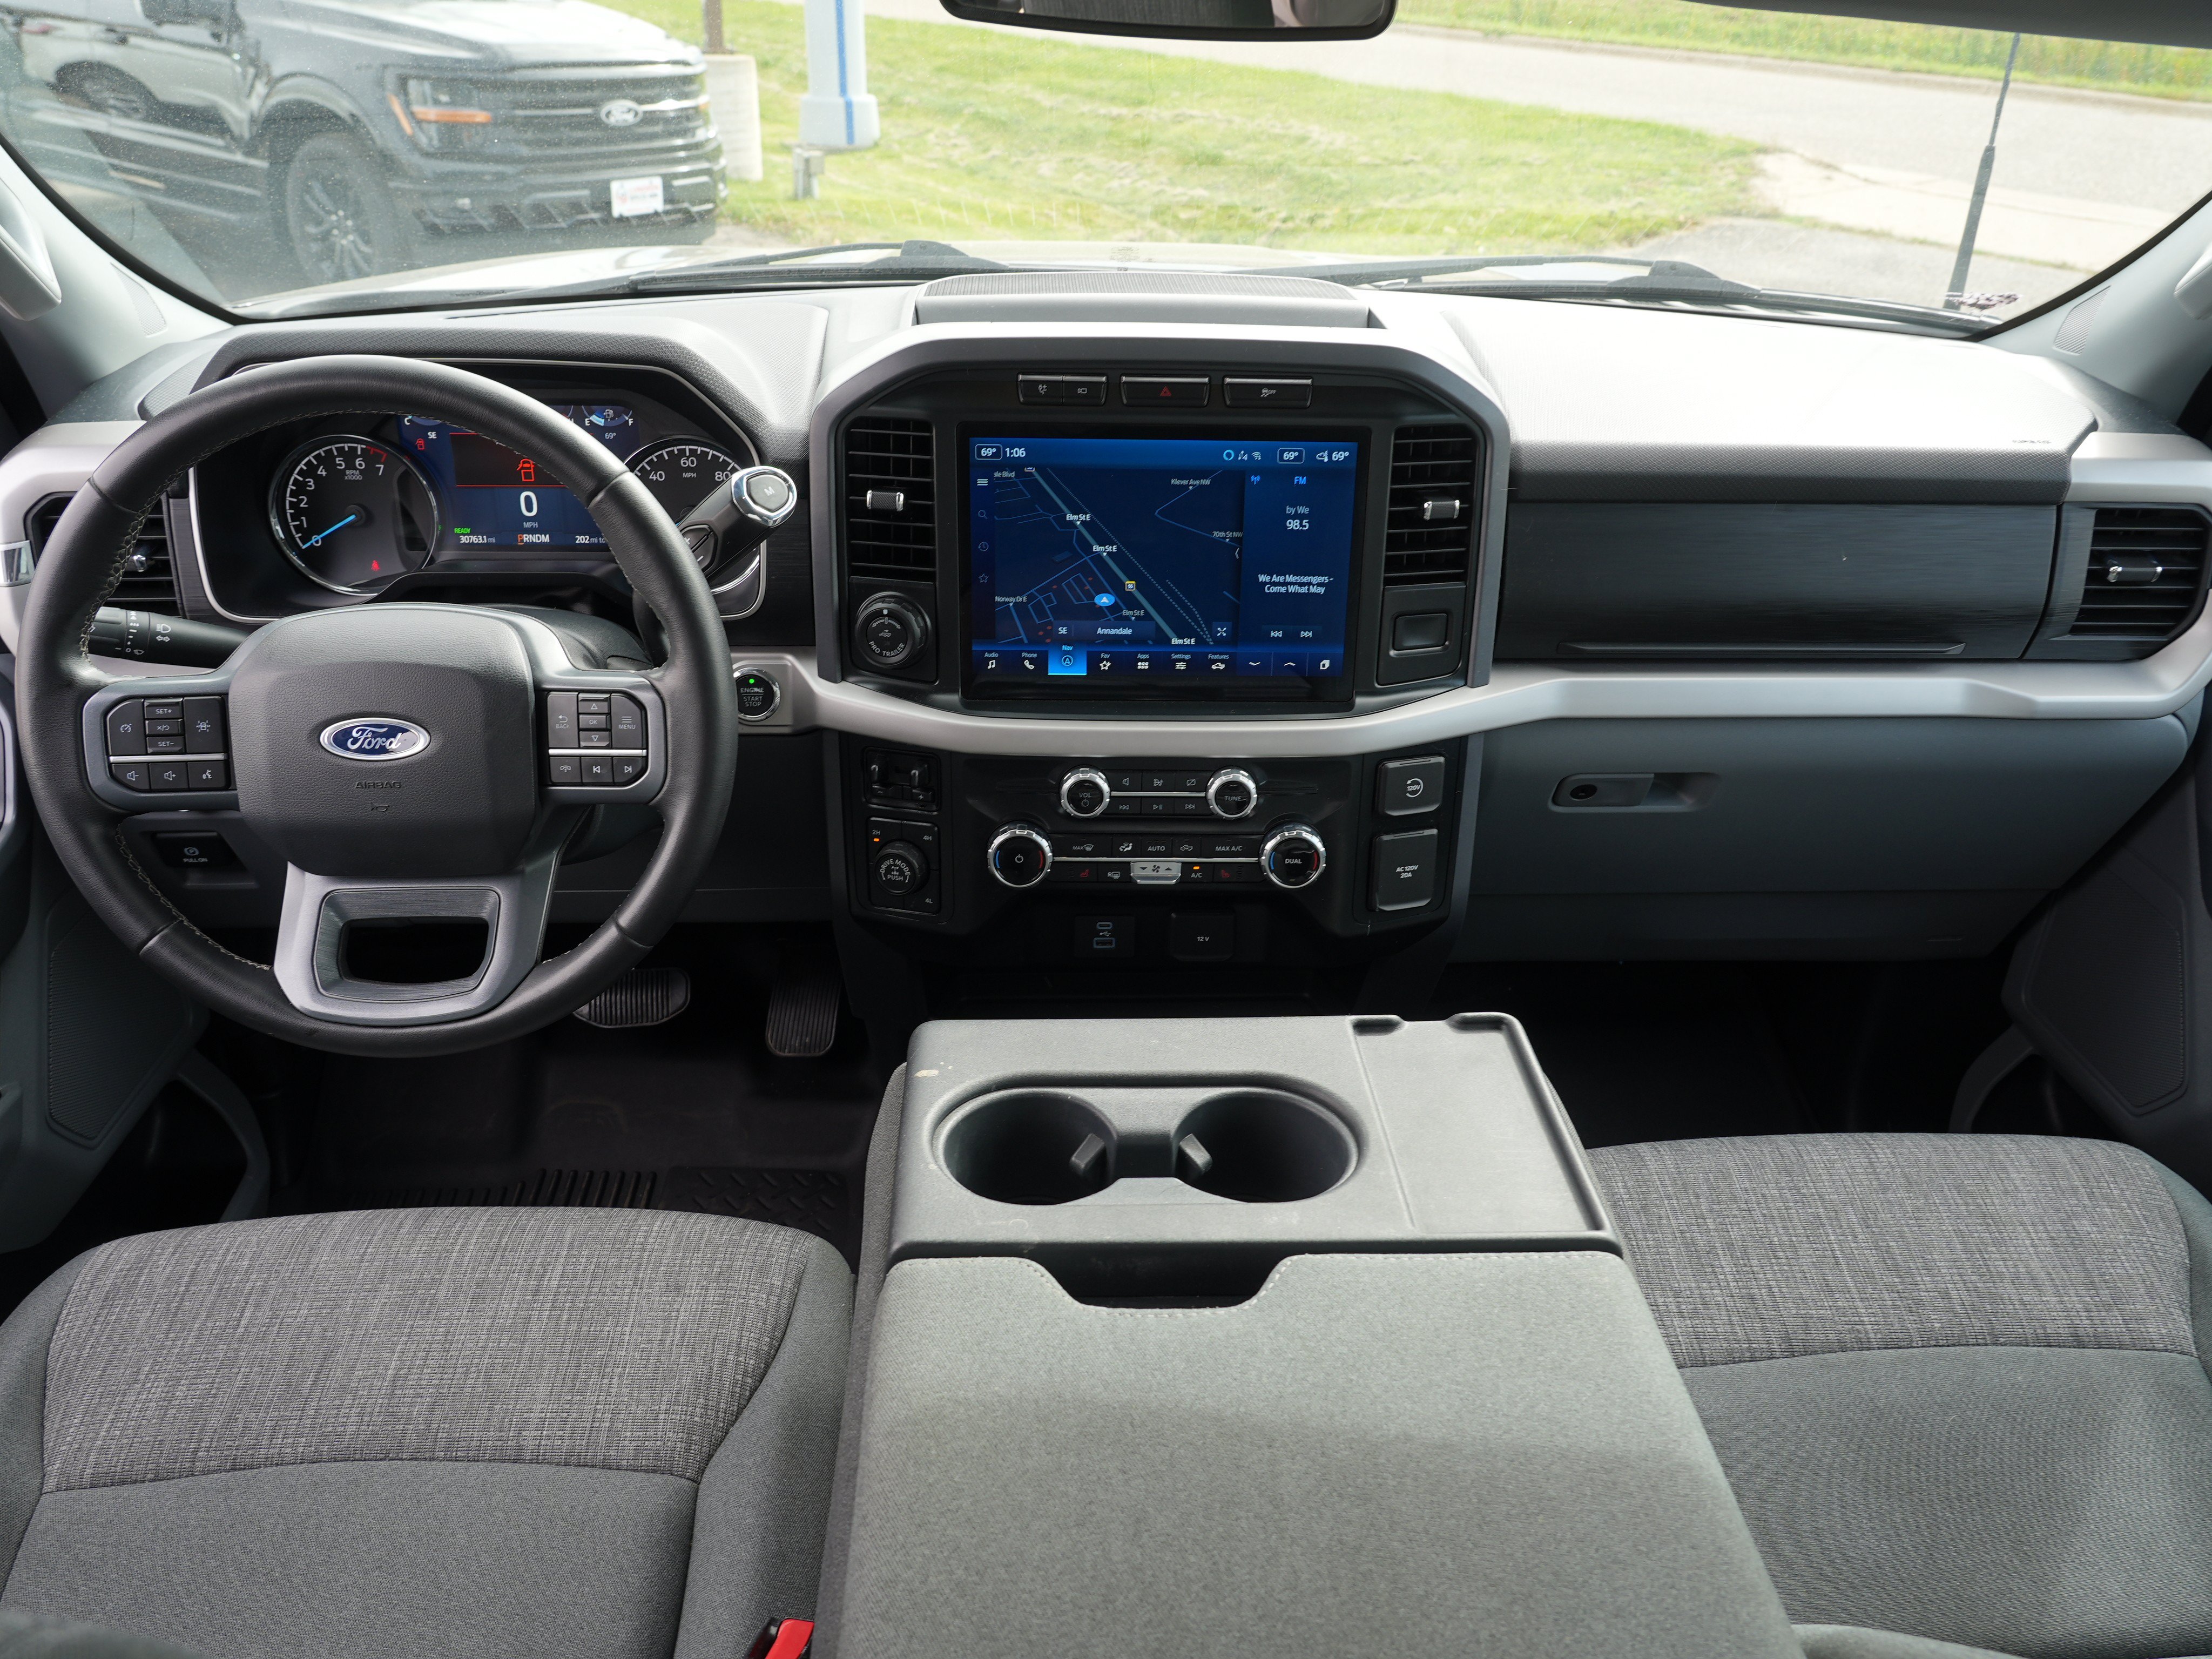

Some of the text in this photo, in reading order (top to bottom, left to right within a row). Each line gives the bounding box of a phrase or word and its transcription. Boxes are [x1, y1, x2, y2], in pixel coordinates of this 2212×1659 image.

[629, 418, 634, 426] F
[981, 448, 996, 457] 69°
[1005, 448, 1026, 457] 1:06
[1283, 451, 1299, 460] 69°
[1332, 451, 1349, 461] 69°
[336, 458, 346, 469] 5
[356, 458, 366, 469] 6
[680, 457, 697, 467] 60
[318, 467, 327, 477] 4
[376, 465, 385, 476] 7
[649, 471, 665, 481] 40
[715, 471, 730, 481] 80
[306, 479, 315, 490] 3
[764, 487, 775, 496] M
[299, 496, 309, 507] 2
[520, 491, 538, 517] 0
[1286, 505, 1310, 515] by We
[1286, 520, 1309, 530] 98.5
[460, 535, 487, 543] 30763.1
[517, 534, 550, 545] PRNDM
[1258, 574, 1271, 582] We
[1272, 574, 1284, 582] Are
[1285, 574, 1329, 584] Messengers
[1265, 585, 1325, 594] Come What May
[1097, 627, 1132, 635] Annandale
[868, 641, 906, 657] PRO TRAILER
[347, 726, 402, 750] Ford
[880, 859, 911, 876] DRIVE MODE
